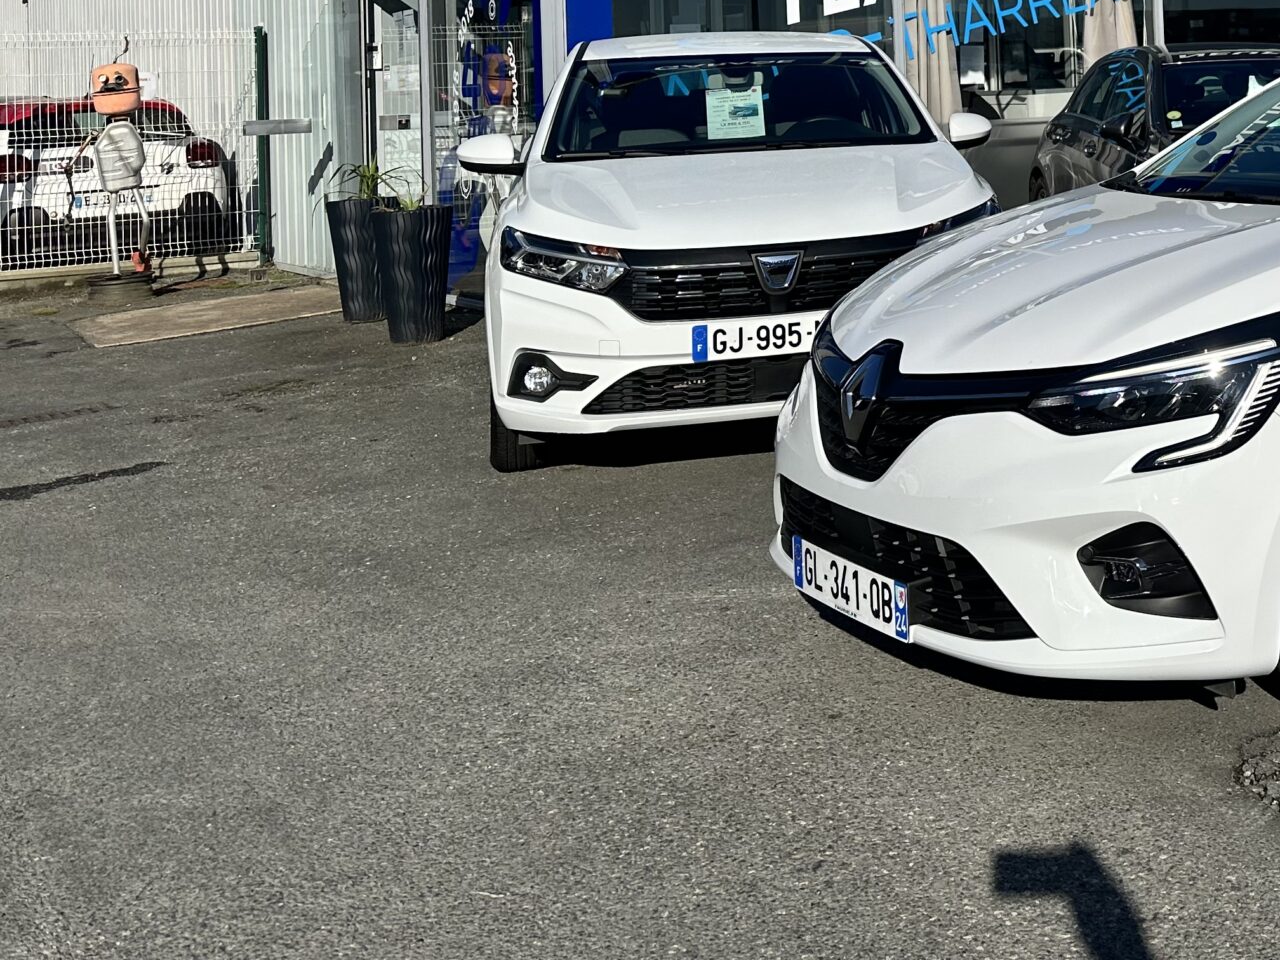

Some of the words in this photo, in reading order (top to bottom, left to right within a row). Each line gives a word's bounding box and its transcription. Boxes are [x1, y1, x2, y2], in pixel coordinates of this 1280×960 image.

[452, 70, 460, 126] 1978
[697, 344, 703, 352] F
[712, 320, 821, 355] GJ-995-
[804, 547, 893, 625] GL-341-QB
[894, 611, 907, 634] 24
